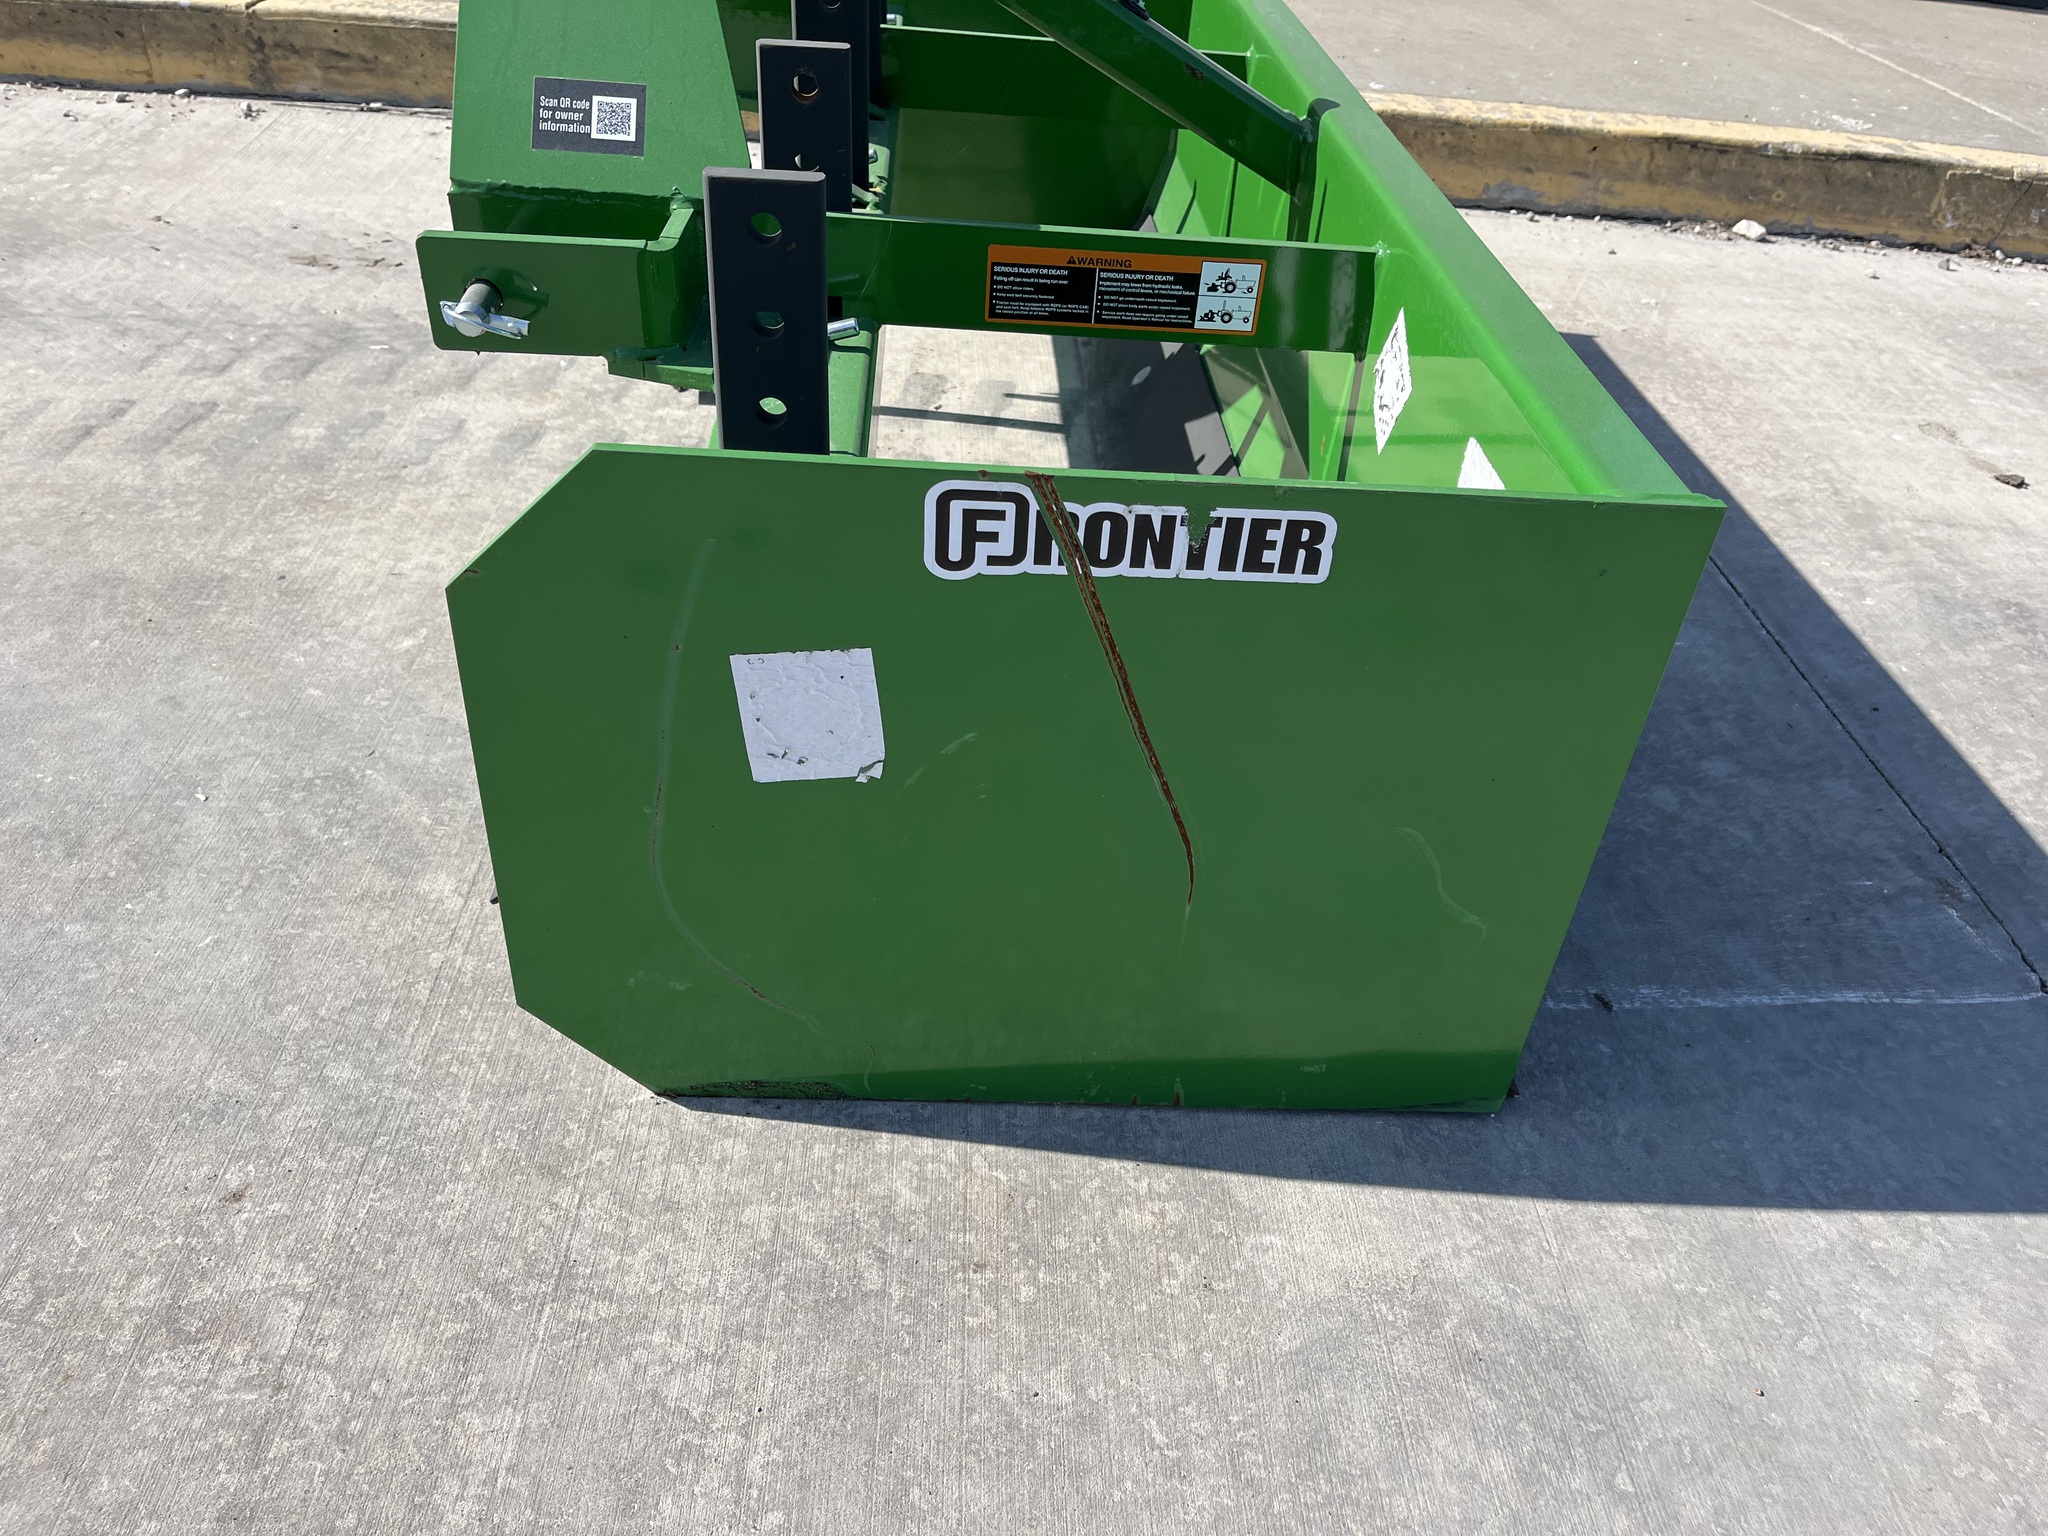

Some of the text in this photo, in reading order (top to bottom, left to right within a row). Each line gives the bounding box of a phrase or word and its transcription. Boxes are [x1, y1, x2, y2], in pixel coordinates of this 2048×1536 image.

[540, 95, 590, 110] Scan QR code
[540, 108, 584, 120] for owner
[539, 120, 590, 133] information
[1077, 256, 1132, 268] WARNING
